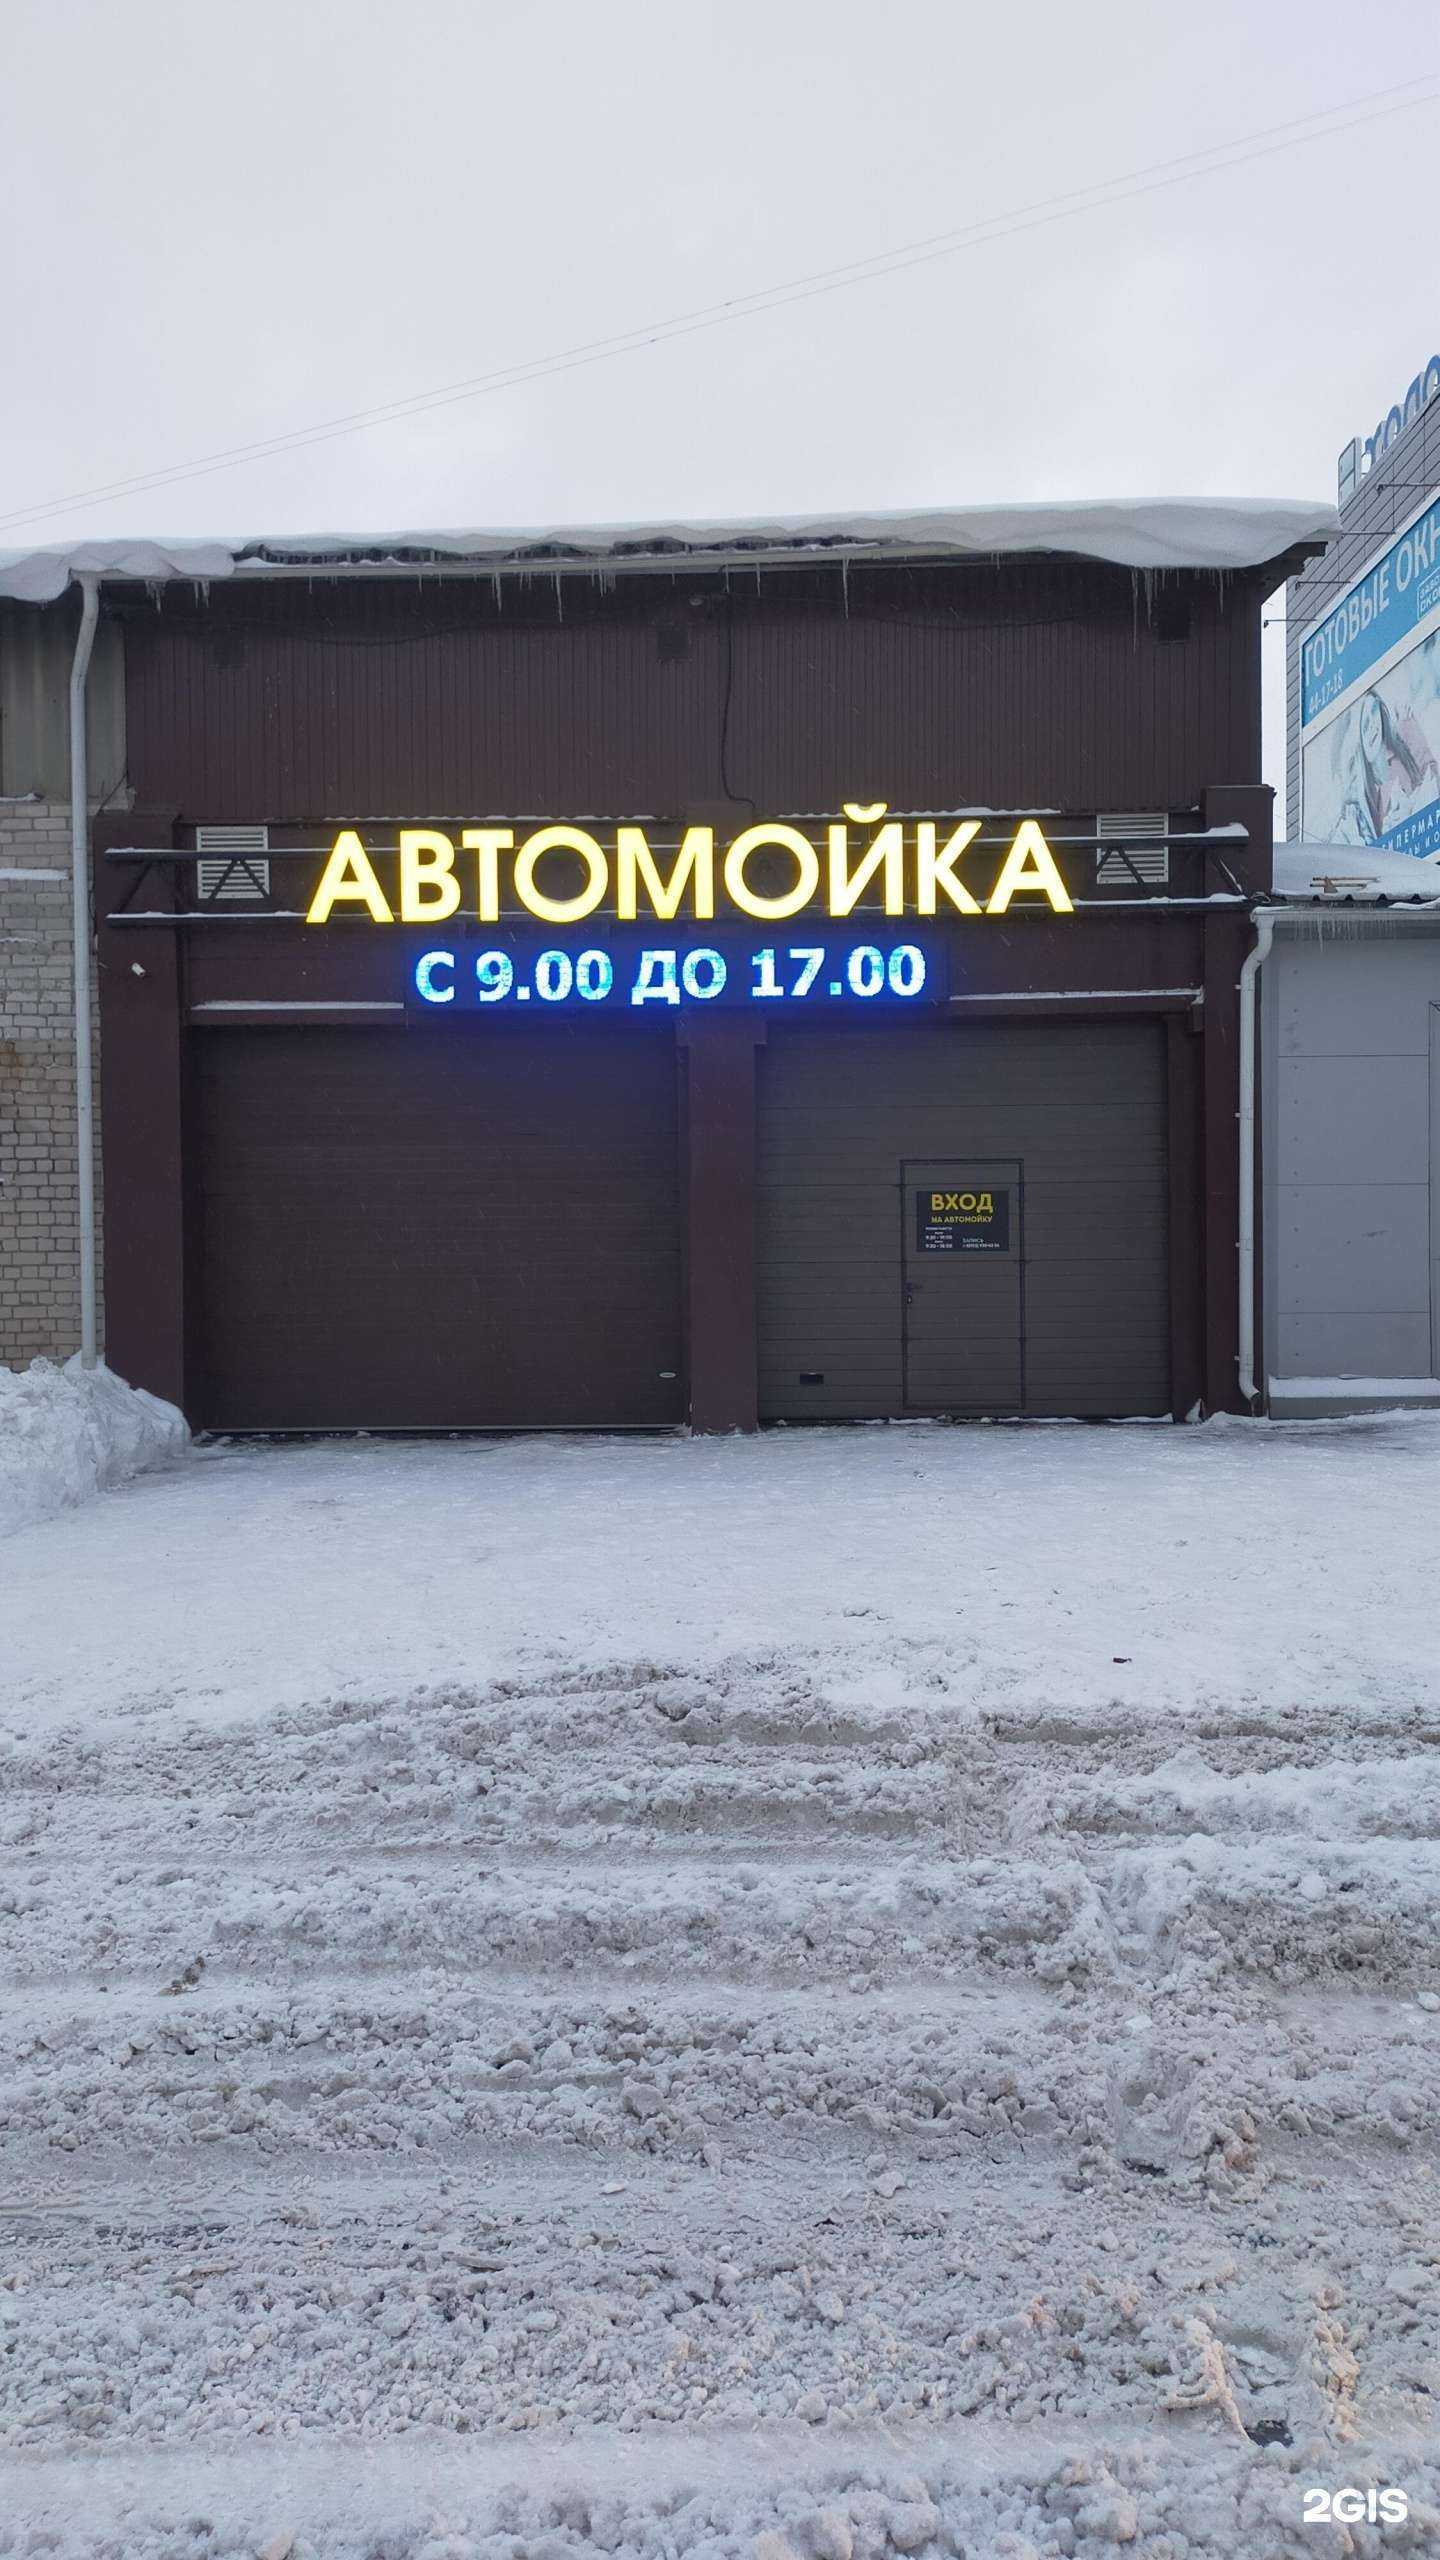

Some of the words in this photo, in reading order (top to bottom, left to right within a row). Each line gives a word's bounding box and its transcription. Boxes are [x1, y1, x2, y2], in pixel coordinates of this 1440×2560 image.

[1304, 560, 1390, 687] ГОТОВЫЕ
[306, 803, 1074, 923] АВТОМОЙКА
[415, 951, 455, 1004] С
[476, 949, 613, 1003] 9.00
[631, 947, 728, 1006] ДО
[751, 945, 926, 998] 17.00
[931, 1193, 993, 1213] ВХОД
[944, 1215, 993, 1223] АВТОМОЙКУ
